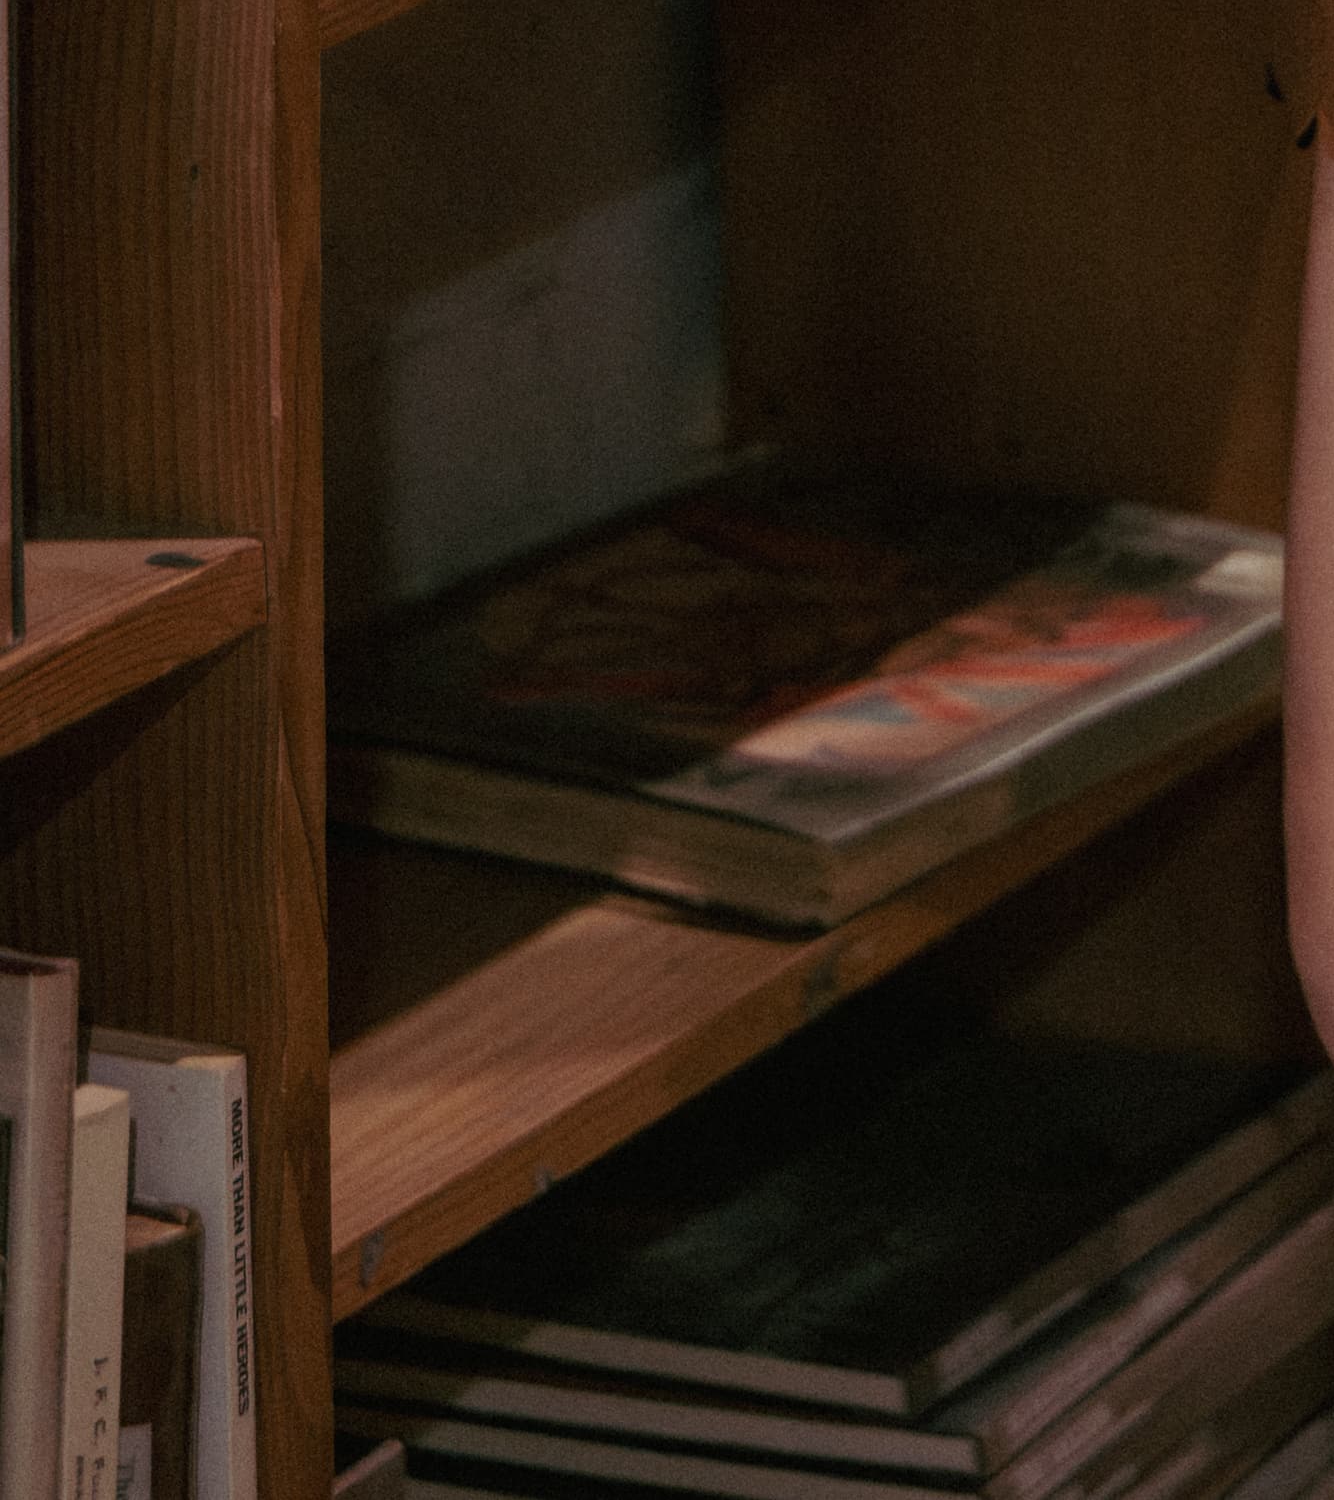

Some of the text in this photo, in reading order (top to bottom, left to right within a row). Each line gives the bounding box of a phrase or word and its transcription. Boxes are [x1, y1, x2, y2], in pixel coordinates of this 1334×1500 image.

[231, 1097, 250, 1416] MORE THAN LITTLE HEROES
